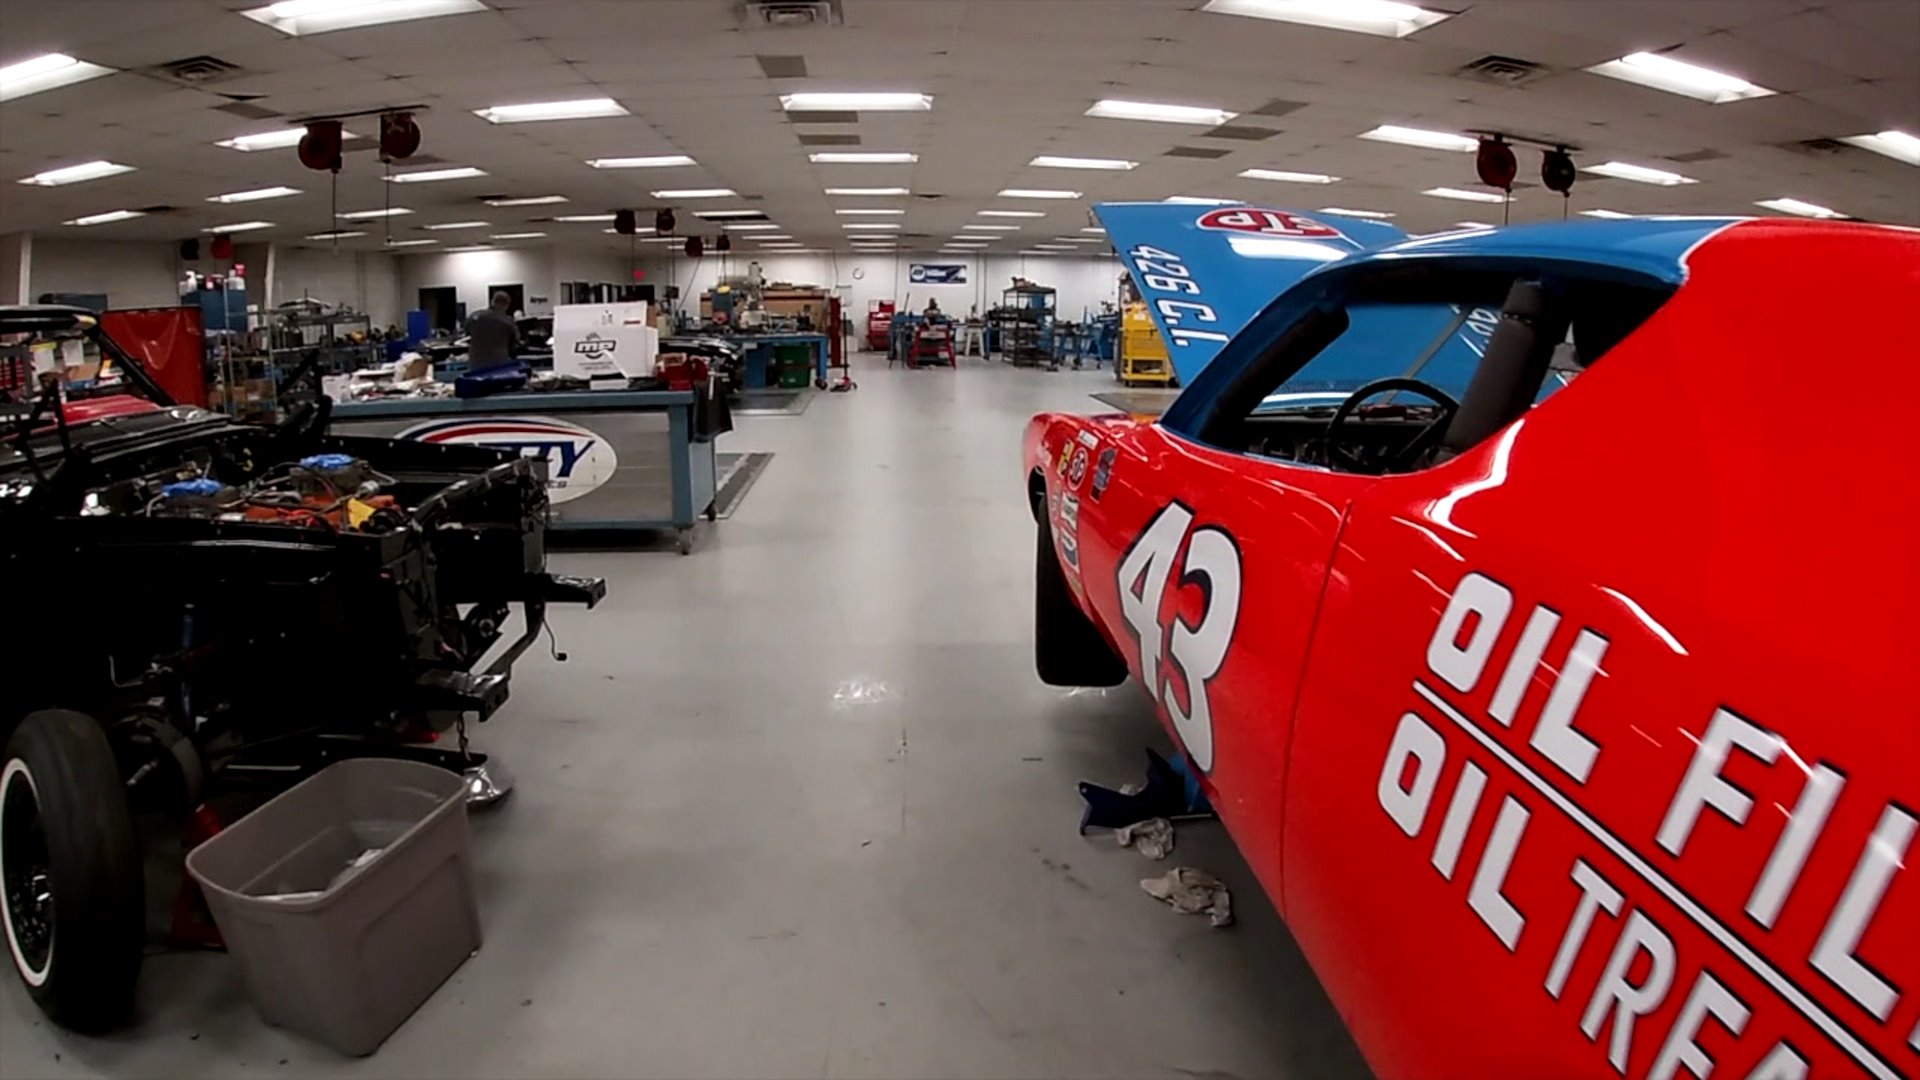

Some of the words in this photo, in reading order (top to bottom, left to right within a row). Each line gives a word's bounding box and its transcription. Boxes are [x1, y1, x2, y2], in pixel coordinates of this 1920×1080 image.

[1129, 244, 1200, 296] 426
[1217, 211, 1325, 234] STP
[1116, 499, 1243, 775] 43
[1377, 711, 1532, 954] OIL
[1426, 571, 1611, 785] OIL
[1655, 704, 1920, 1052] FIL
